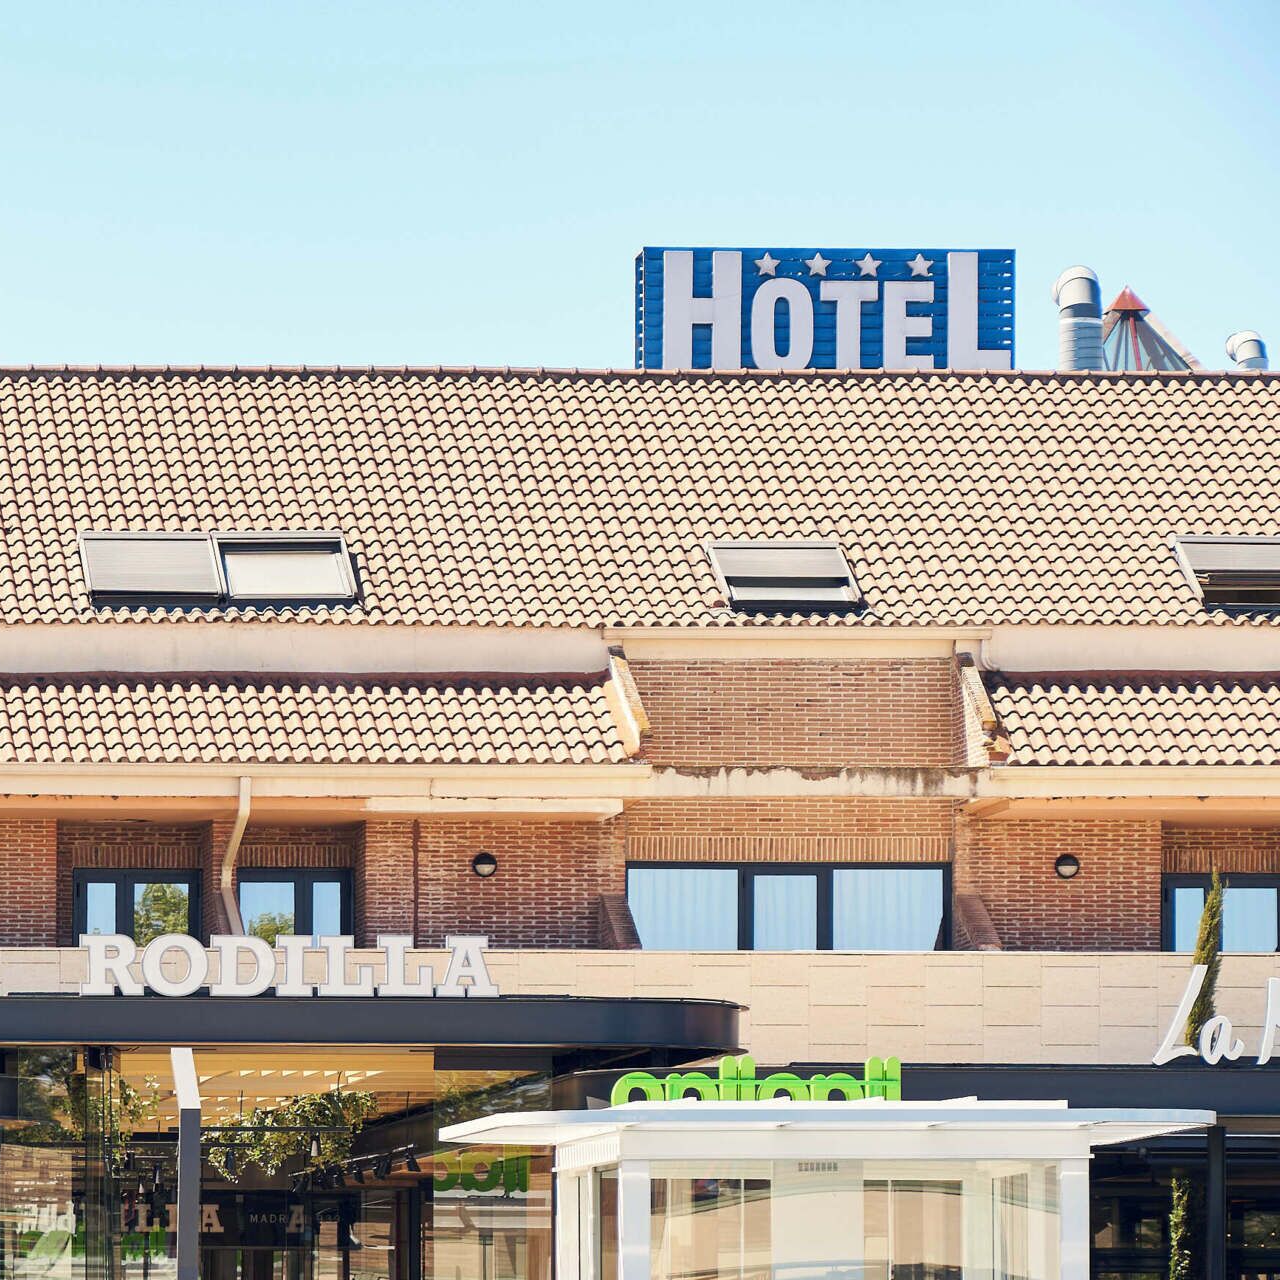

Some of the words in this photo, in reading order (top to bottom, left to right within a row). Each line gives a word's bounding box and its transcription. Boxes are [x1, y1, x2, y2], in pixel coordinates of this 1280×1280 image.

[662, 250, 1012, 370] HOTEL
[79, 932, 500, 998] RODILLA
[1151, 964, 1246, 1066] La
